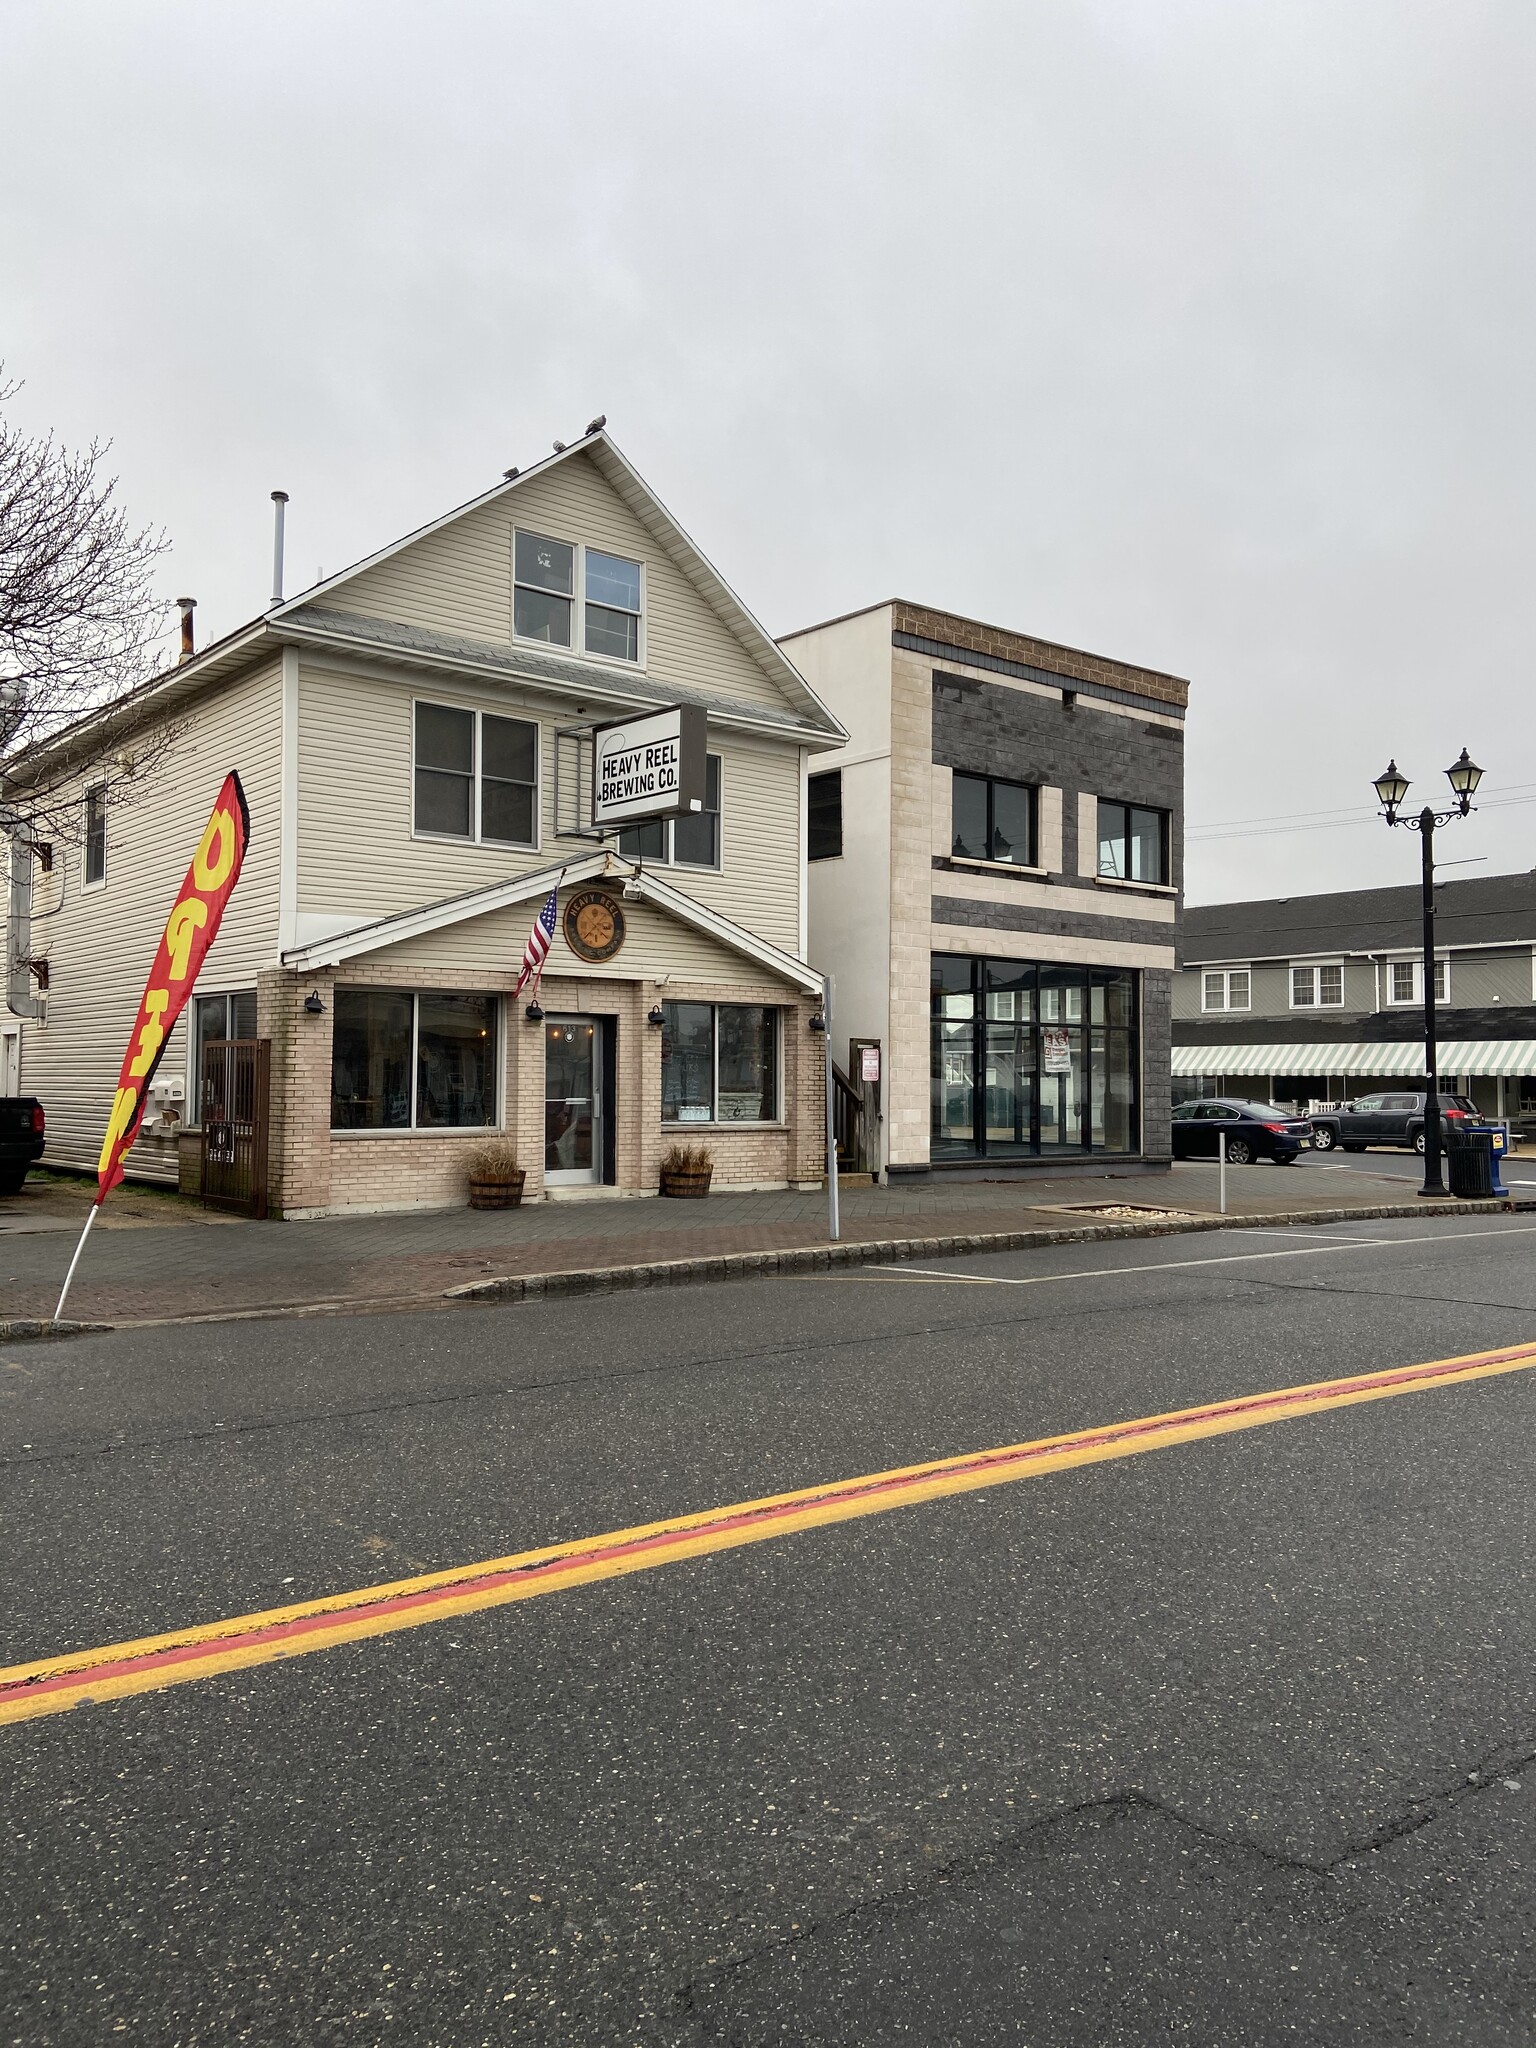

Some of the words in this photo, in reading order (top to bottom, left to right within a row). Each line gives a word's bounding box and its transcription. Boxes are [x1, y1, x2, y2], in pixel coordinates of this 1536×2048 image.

[602, 753, 641, 780] HEAVY
[645, 745, 677, 769] REEL
[602, 773, 654, 801] BREWING
[658, 768, 677, 788] CO.
[570, 894, 595, 917] HEAVY
[600, 896, 619, 918] REEL
